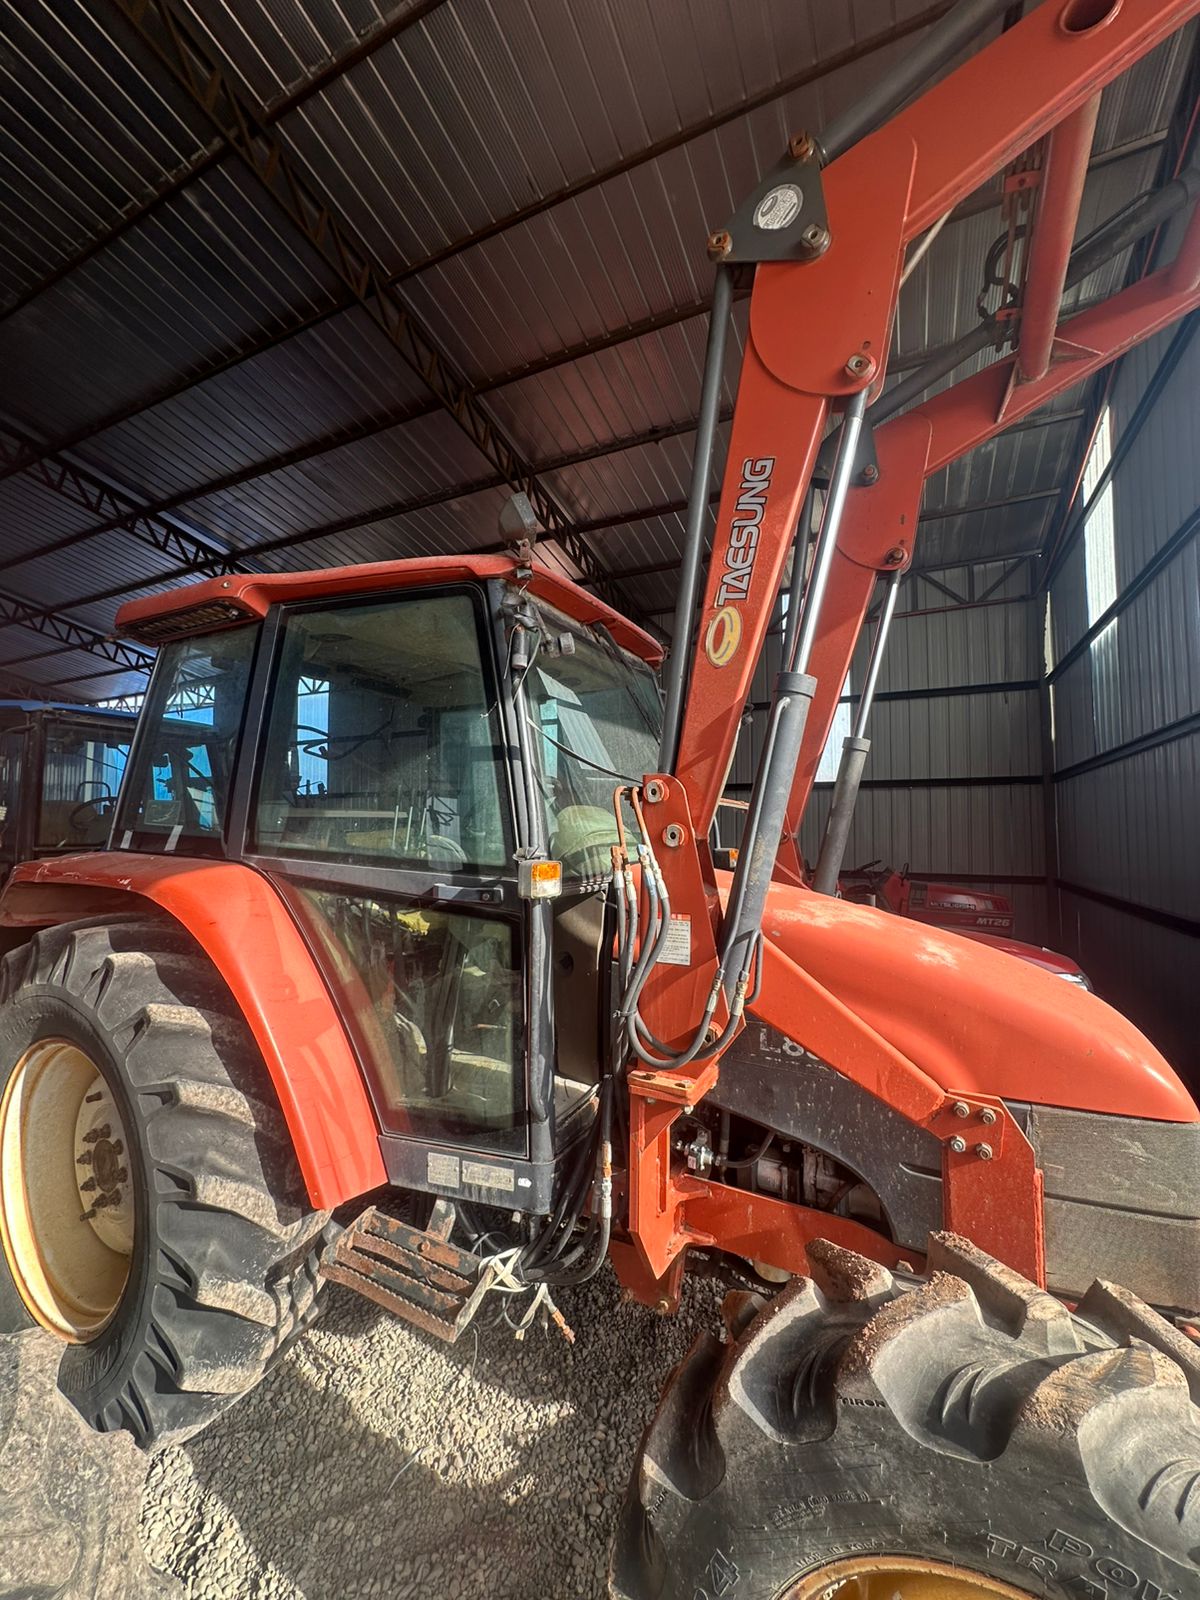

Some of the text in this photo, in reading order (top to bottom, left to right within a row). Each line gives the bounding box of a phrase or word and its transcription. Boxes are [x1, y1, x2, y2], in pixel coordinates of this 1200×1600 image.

[715, 456, 776, 607] TAESUNG
[976, 917, 1010, 927] MT26
[759, 1028, 820, 1061] L8
